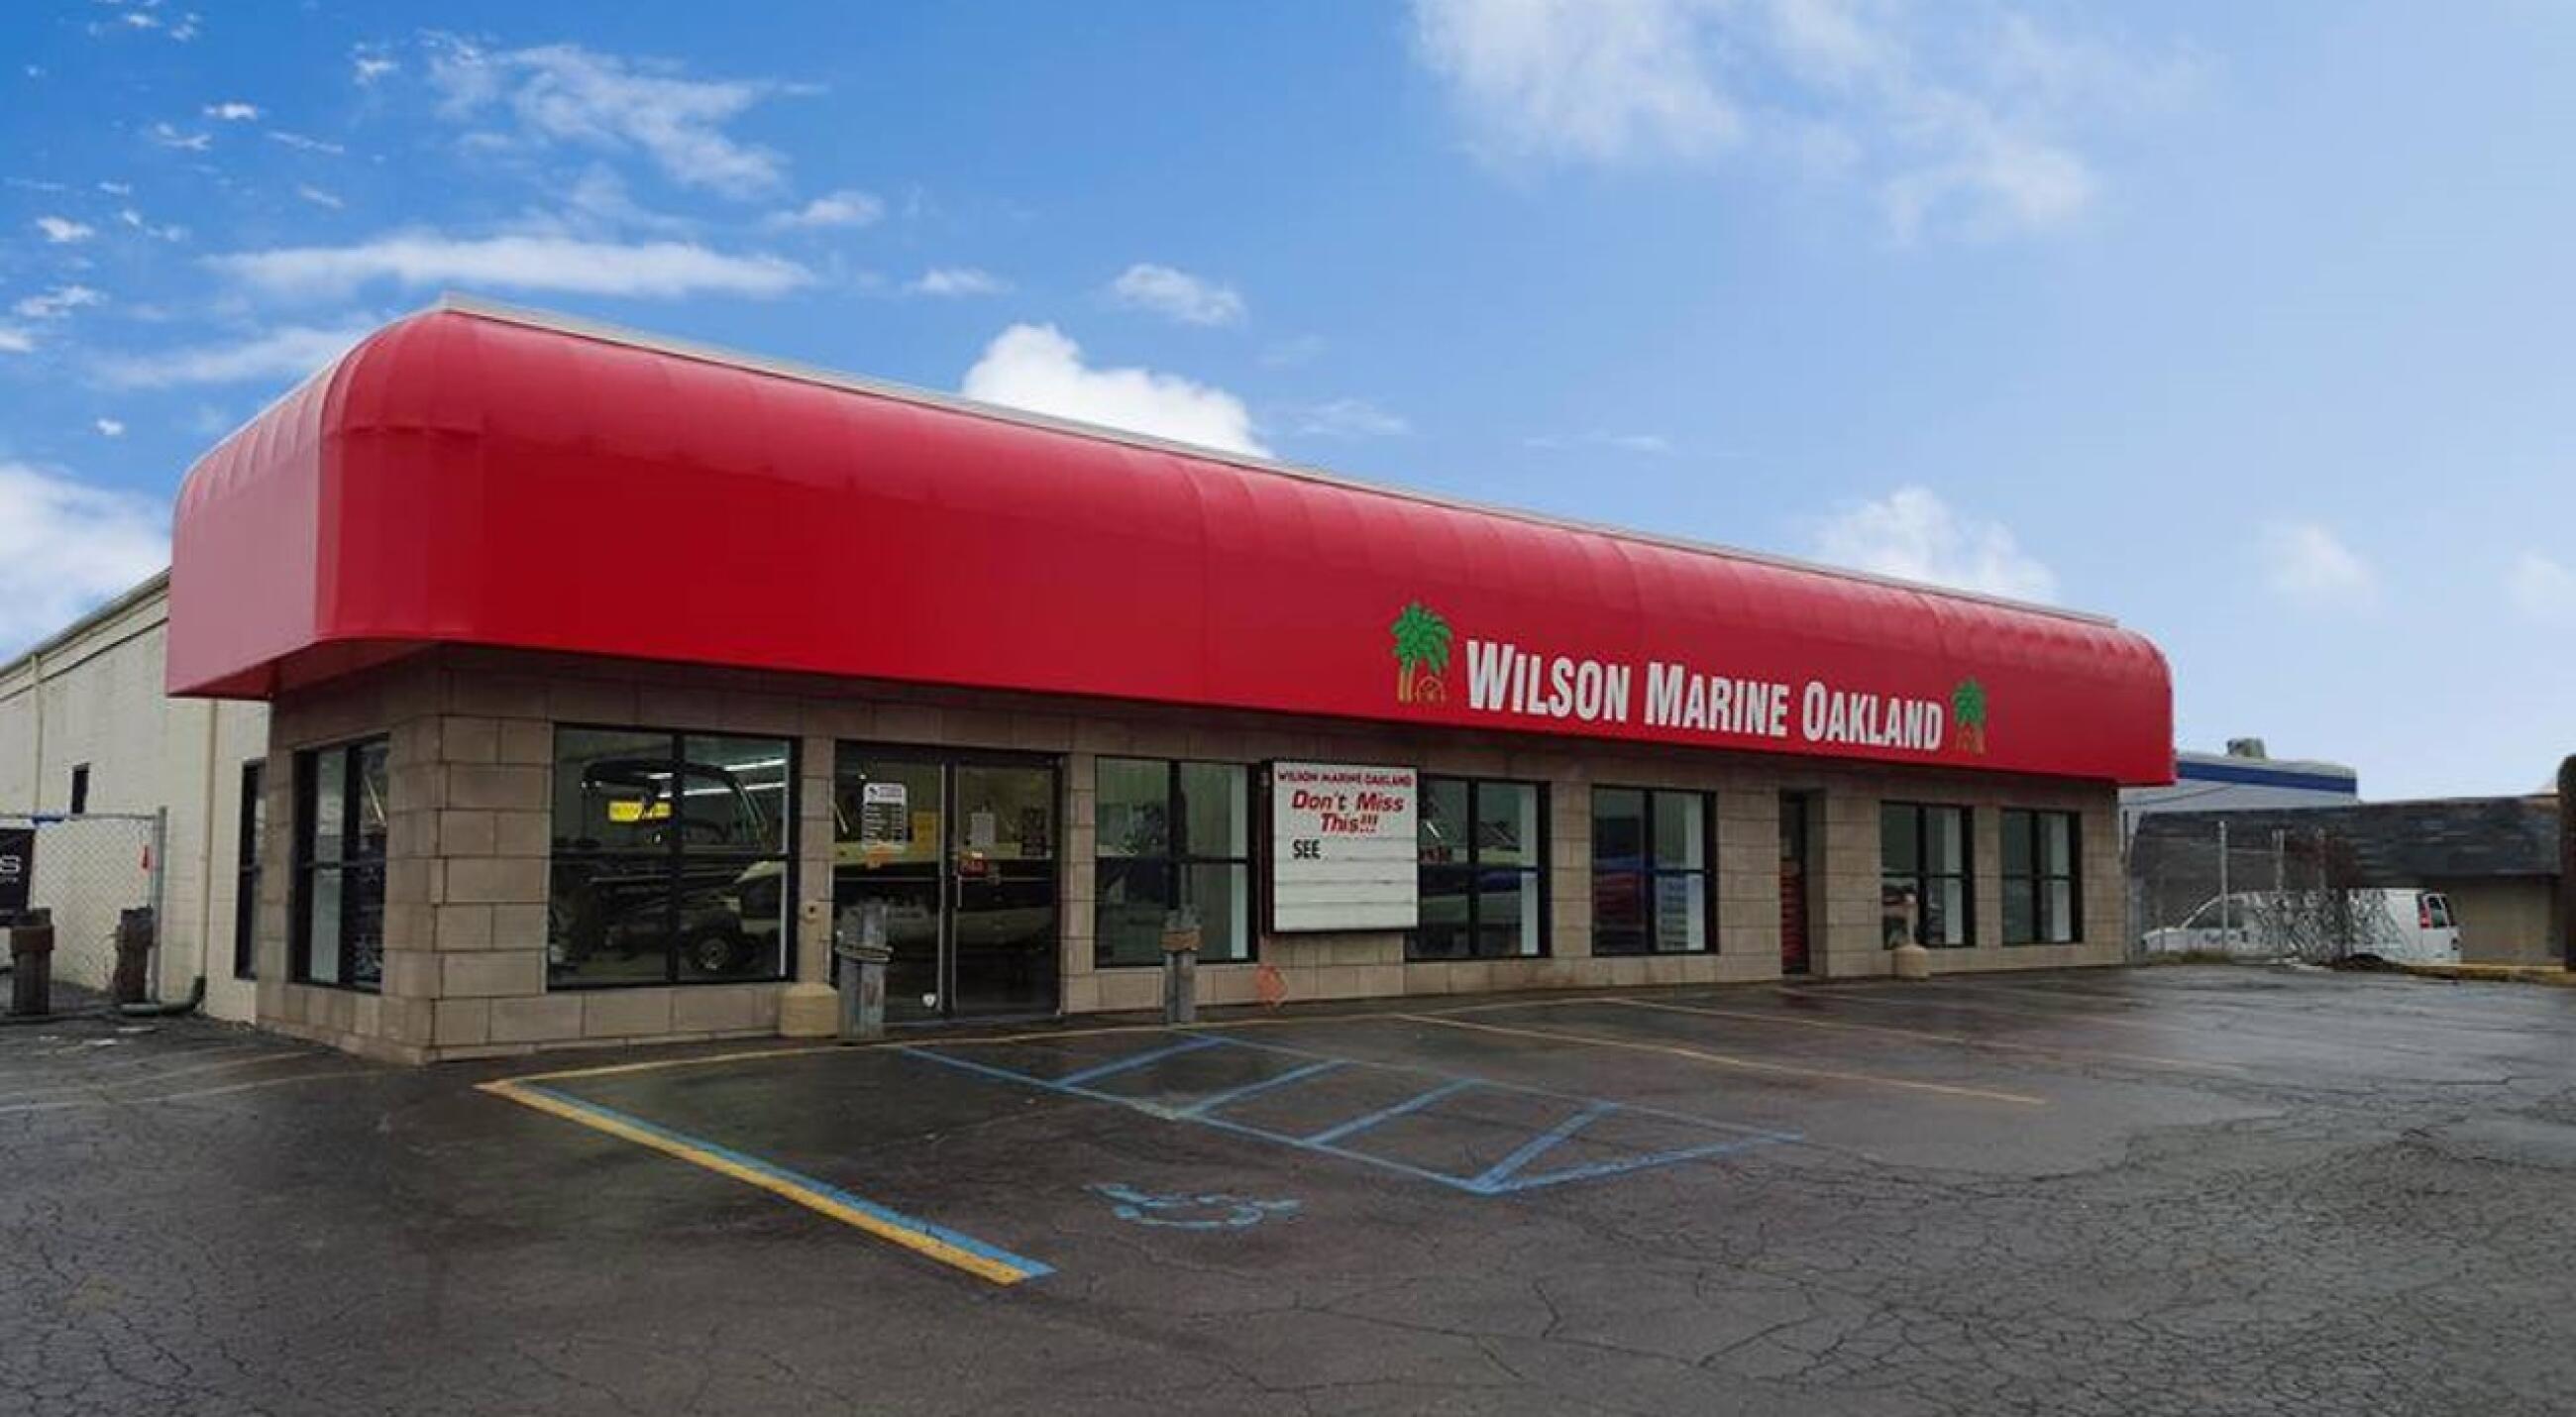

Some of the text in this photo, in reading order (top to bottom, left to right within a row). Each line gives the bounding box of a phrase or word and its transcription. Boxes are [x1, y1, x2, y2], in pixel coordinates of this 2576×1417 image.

[1466, 639, 1943, 751] WILSON MARINE OAKLAND
[1278, 770, 1319, 783] WILSON
[1292, 790, 1405, 813] Don't Miss
[1321, 813, 1379, 833] This!!!
[1293, 838, 1322, 861] SEE
